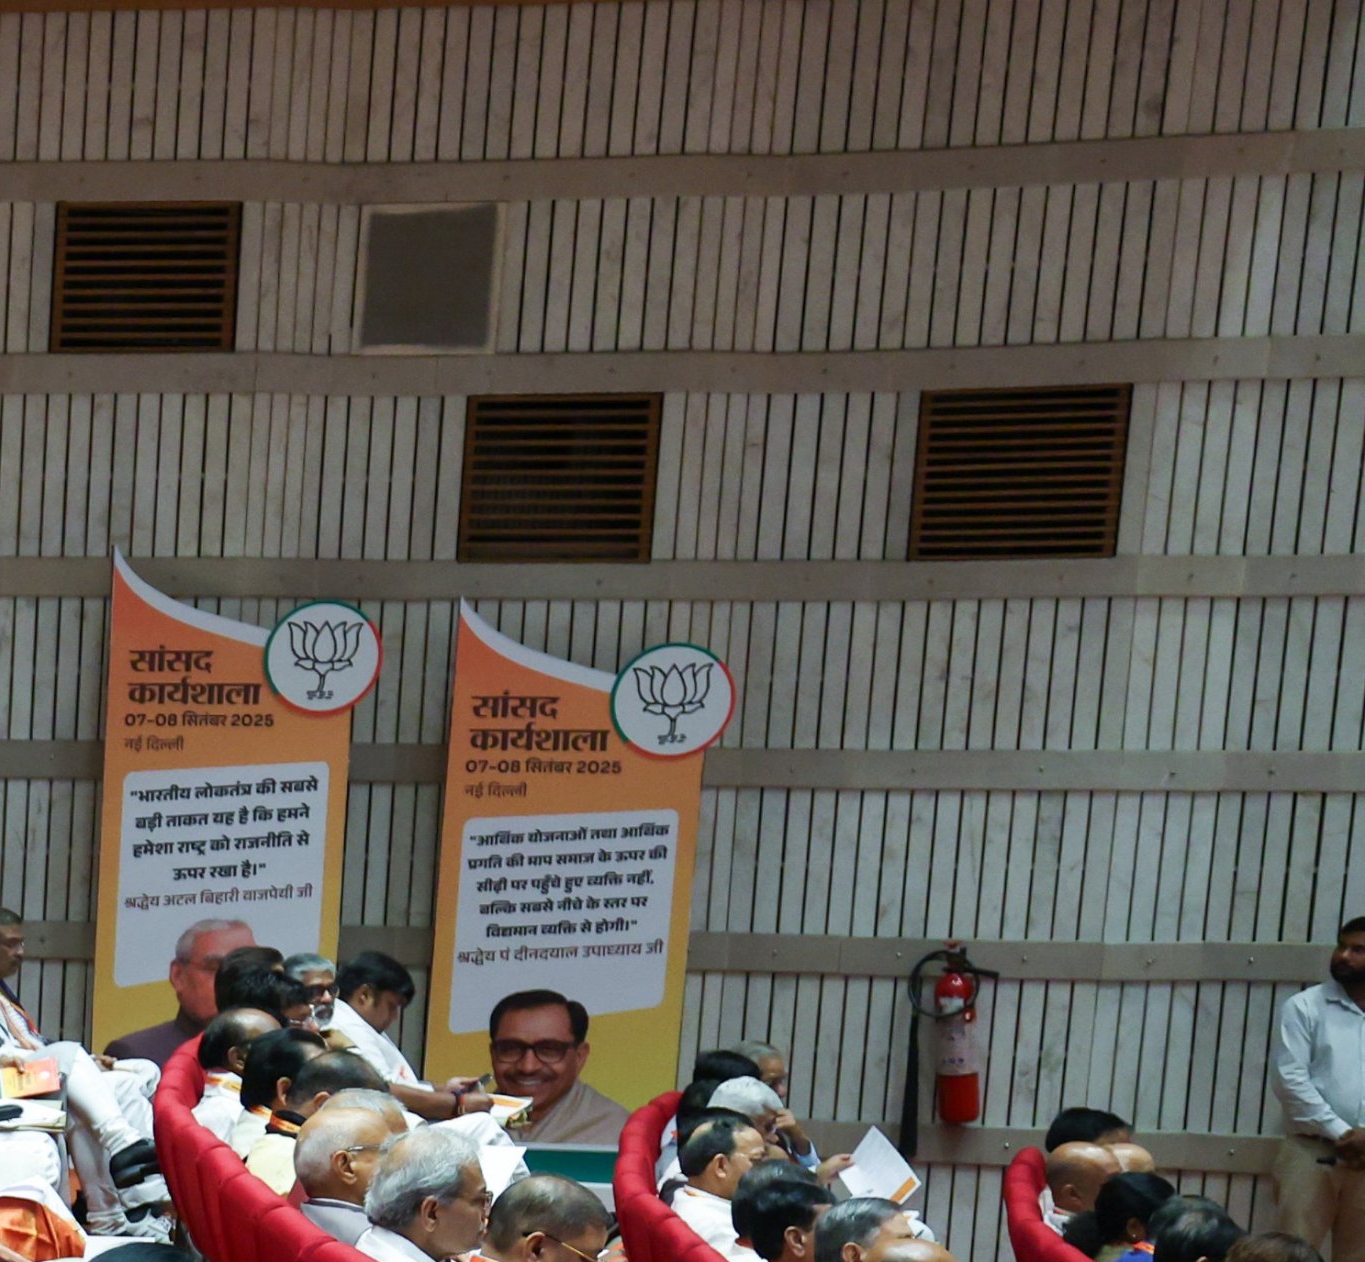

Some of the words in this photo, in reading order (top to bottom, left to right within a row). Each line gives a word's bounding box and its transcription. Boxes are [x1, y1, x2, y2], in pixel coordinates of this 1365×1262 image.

[129, 645, 213, 673] सांसद
[128, 676, 261, 705] कार्यशाला
[125, 713, 177, 727] 07-08
[182, 711, 227, 727] सितंबर
[231, 713, 274, 727] 2025
[471, 690, 560, 720] सांसद
[125, 735, 143, 752] नई
[147, 735, 185, 751] दिल्ली
[470, 722, 610, 752] कार्यशाला
[465, 760, 521, 774] 07-08
[525, 757, 572, 774] सितंबर
[576, 760, 622, 774] 2025
[195, 781, 252, 800] लोकतंत्र
[256, 778, 276, 794] की
[280, 775, 318, 793] सबसे
[465, 782, 484, 798] नई
[488, 782, 527, 798] दिल्ली
[136, 812, 162, 832] बड़ी
[166, 813, 209, 827] ताकत
[213, 811, 235, 826] यह
[238, 805, 249, 825] है
[253, 805, 273, 822] कि
[277, 802, 310, 822] हमने
[133, 839, 173, 858] हमेशा
[177, 840, 206, 856] राष्ट्र
[210, 835, 230, 852] को
[234, 831, 293, 850] राजनीति
[296, 830, 310, 846] से
[173, 867, 206, 881] ऊपर
[210, 865, 237, 879] रखा
[125, 893, 160, 911] श्रद्धेय
[163, 892, 196, 907] अटल
[200, 887, 239, 905] बिहारी
[243, 884, 293, 901] वाजपेयी
[297, 882, 313, 898] जी
[457, 948, 495, 966] श्रद्धेय
[500, 947, 509, 961] पं
[514, 944, 578, 961] दीनदयाल
[583, 943, 642, 958] उपाध्याय
[646, 938, 663, 955] जी
